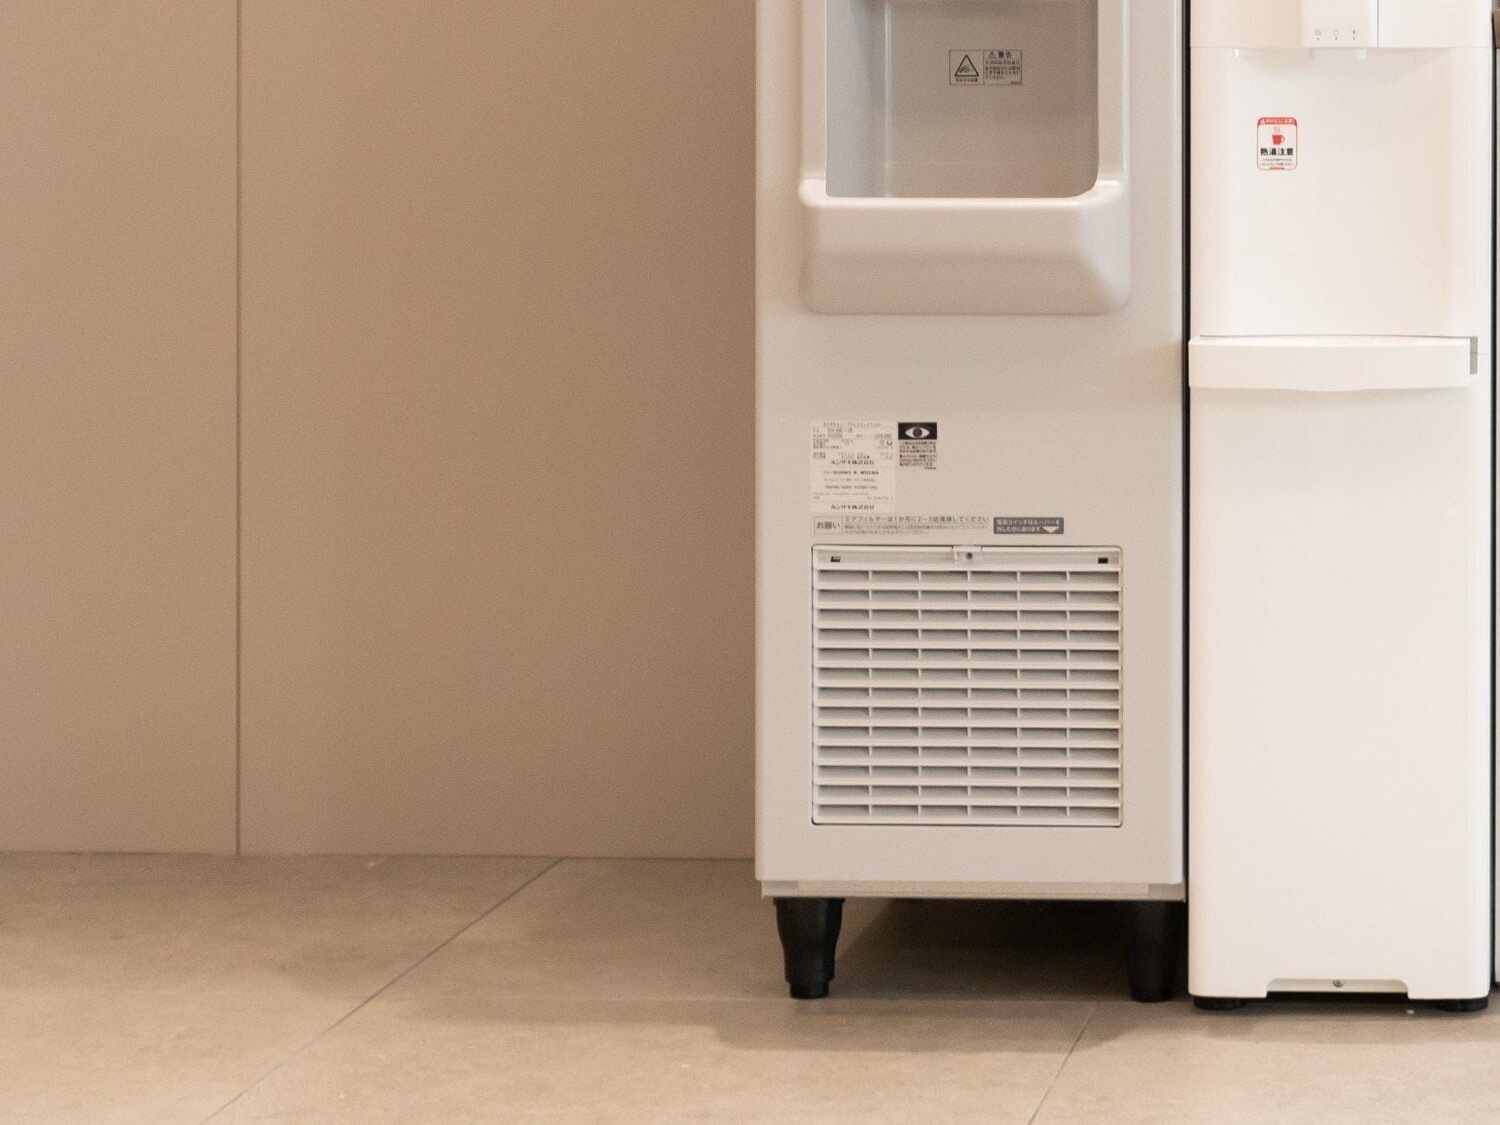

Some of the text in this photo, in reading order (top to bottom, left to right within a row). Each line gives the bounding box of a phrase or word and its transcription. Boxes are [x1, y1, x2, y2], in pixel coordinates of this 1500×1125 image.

[1260, 147, 1294, 156] 熱湯注意
[816, 521, 841, 529] お願い
